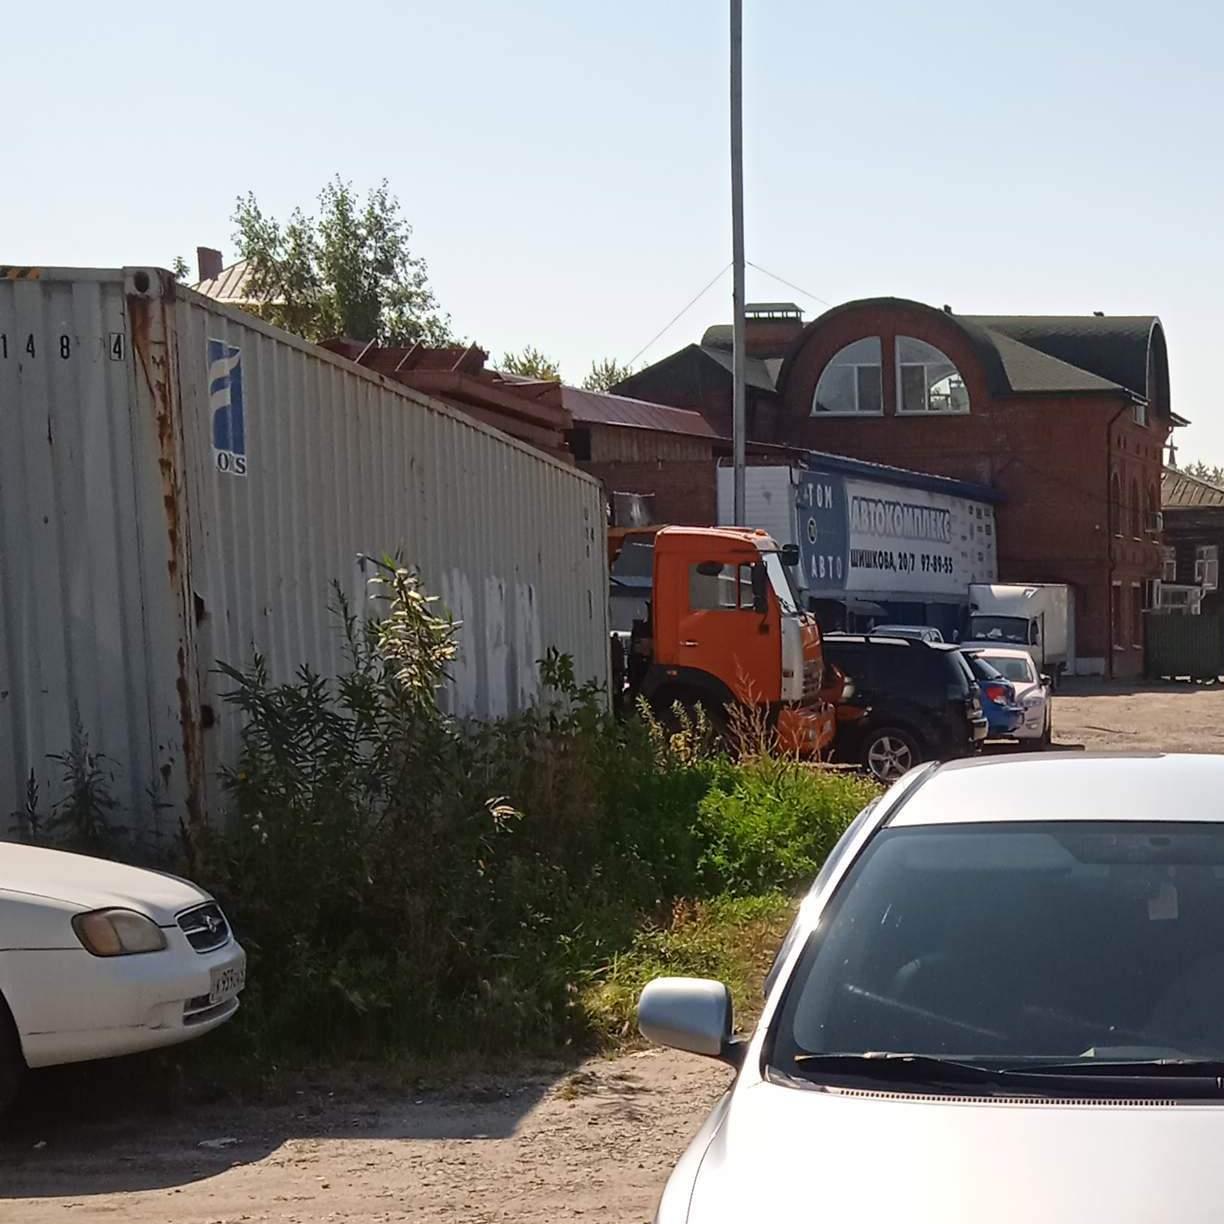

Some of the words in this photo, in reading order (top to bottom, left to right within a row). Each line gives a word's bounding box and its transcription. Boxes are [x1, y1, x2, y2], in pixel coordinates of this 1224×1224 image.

[808, 483, 833, 509] ТОМ
[851, 497, 950, 544] АВТОКОМПЛЕКС
[811, 554, 843, 580] АВТО
[851, 550, 896, 573] ШИШКОВА,
[898, 552, 915, 574] 20/7
